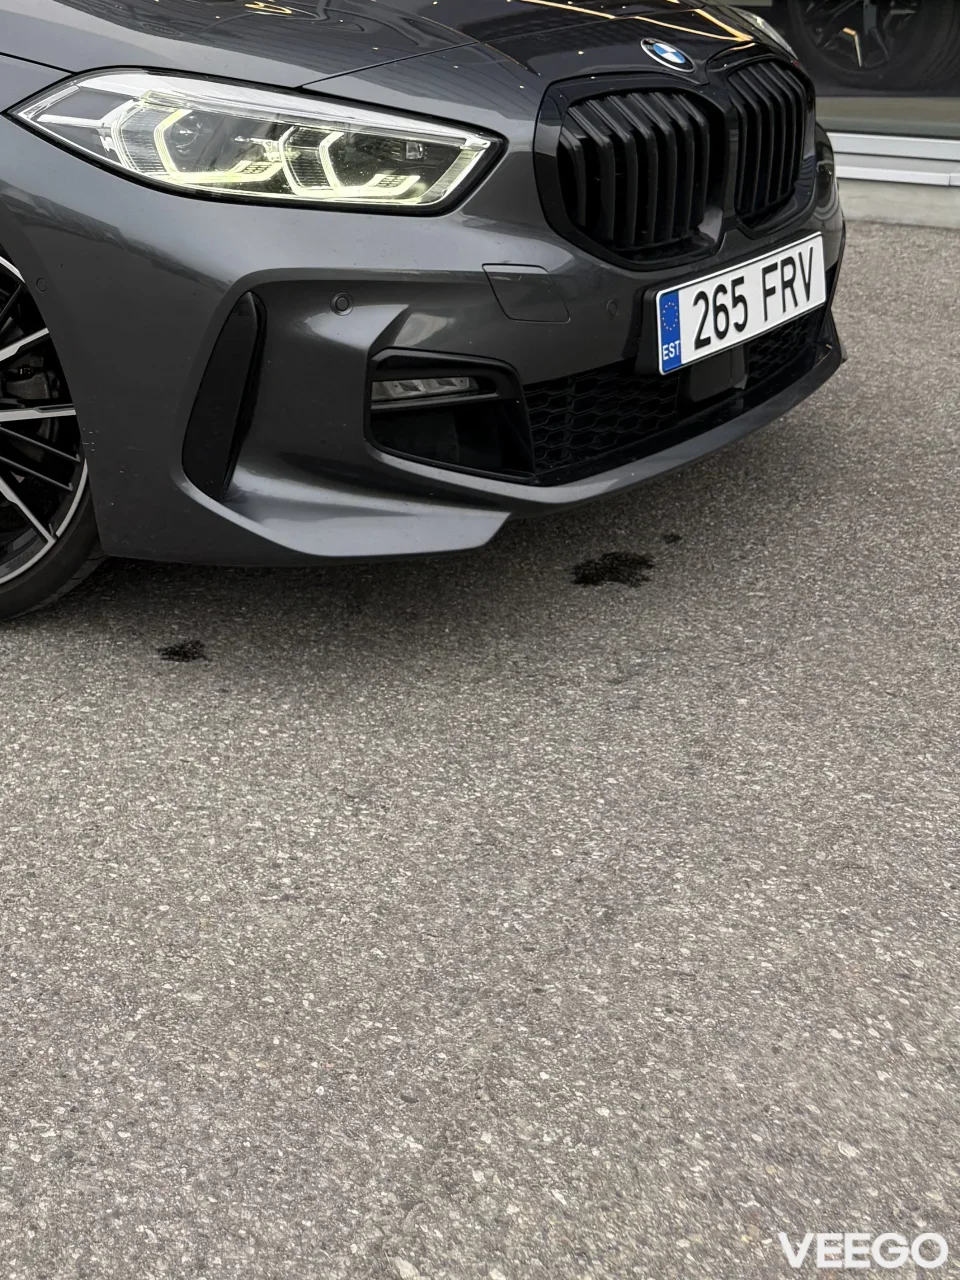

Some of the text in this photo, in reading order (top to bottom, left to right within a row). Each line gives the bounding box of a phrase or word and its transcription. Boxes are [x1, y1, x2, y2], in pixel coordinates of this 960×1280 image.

[692, 246, 814, 351] 265 FRV
[662, 339, 681, 361] EST
